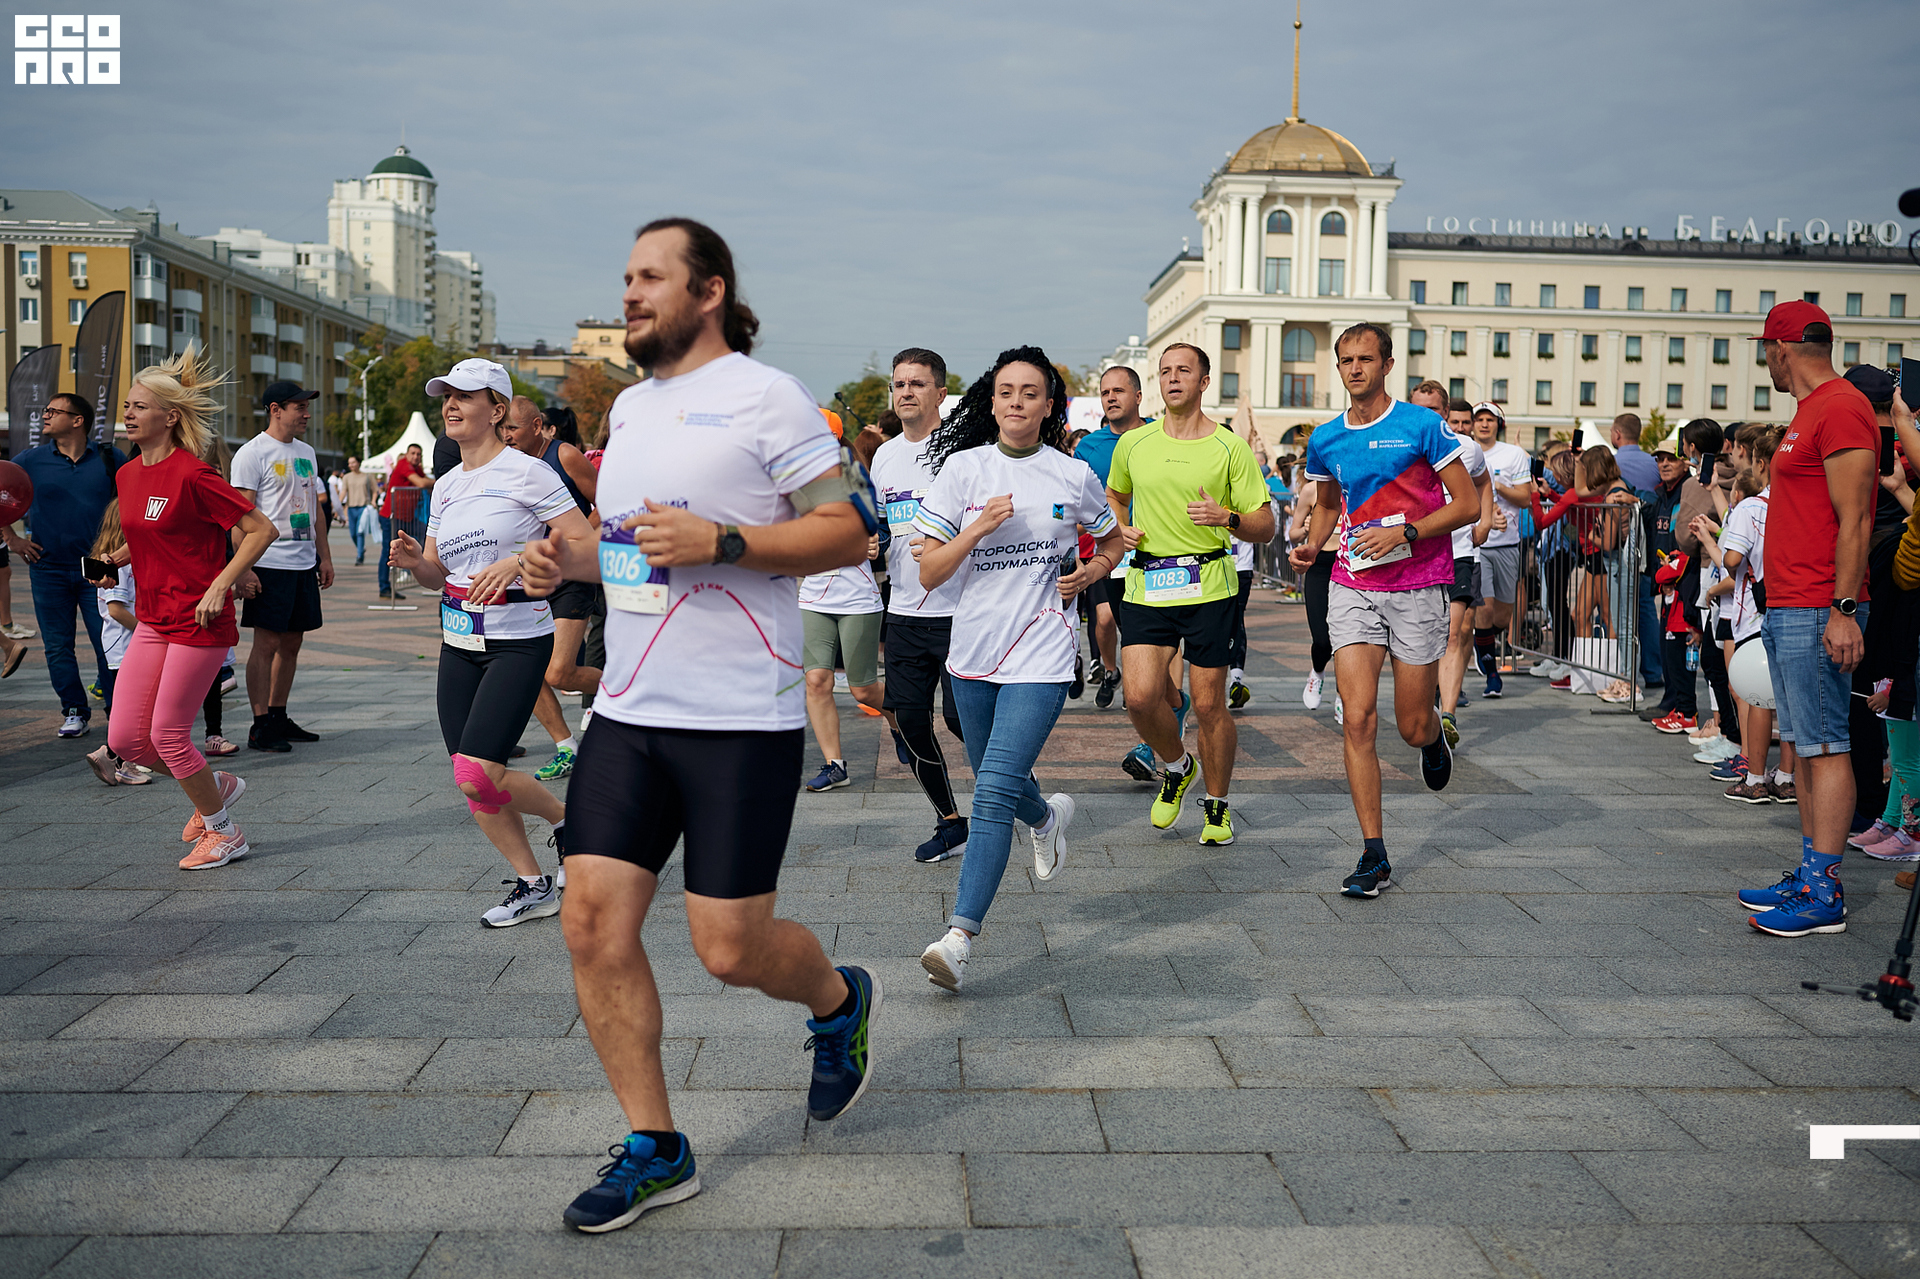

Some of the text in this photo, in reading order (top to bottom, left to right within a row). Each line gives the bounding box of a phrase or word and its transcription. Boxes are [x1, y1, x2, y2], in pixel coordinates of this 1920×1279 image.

[1426, 215, 1612, 238] ГОСТИНИЦА
[891, 503, 914, 521] 1413
[469, 549, 499, 566] 2021
[602, 549, 642, 581] 1306
[1152, 570, 1185, 588] 1083
[444, 610, 468, 632] 1009
